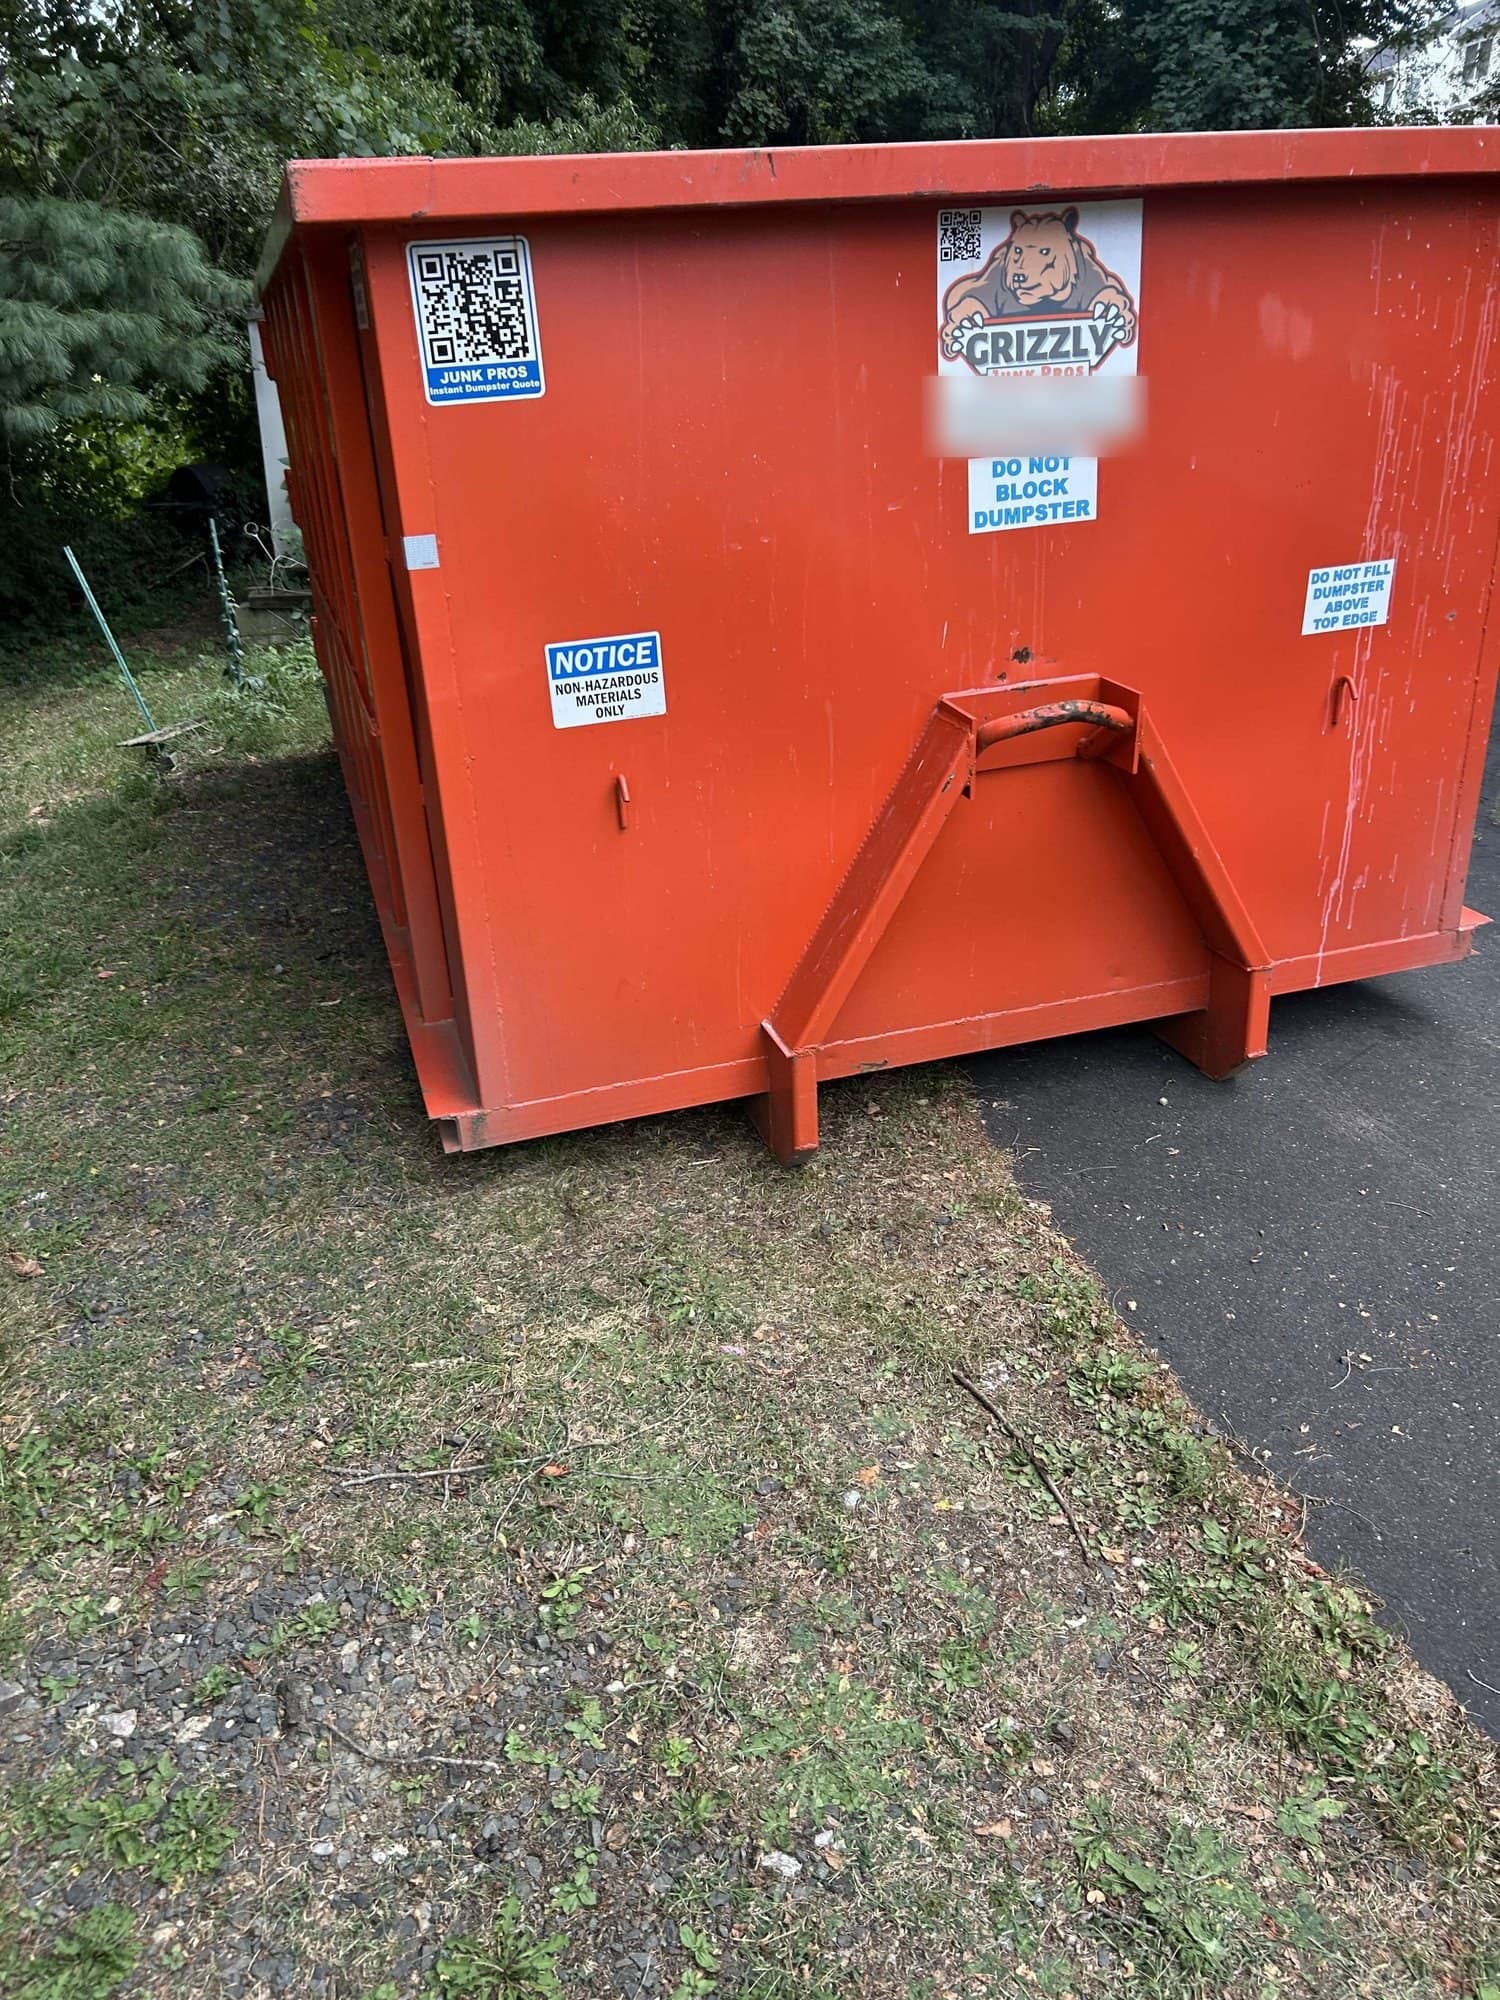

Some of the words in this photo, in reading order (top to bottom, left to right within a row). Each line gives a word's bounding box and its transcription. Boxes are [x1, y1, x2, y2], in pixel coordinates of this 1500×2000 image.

[966, 325, 1112, 365] GRIZZLY
[440, 369, 483, 384] JUNK
[487, 366, 528, 379] PROS
[430, 386, 464, 395] Instant
[465, 382, 510, 393] Dumpster
[512, 379, 540, 389] Quote
[992, 459, 1022, 478] DO
[1029, 456, 1071, 474] NOT
[996, 478, 1069, 502] BLOCK
[974, 499, 1090, 529] DUMPSTER
[1311, 571, 1330, 584] DO
[1333, 567, 1361, 582] NOT
[1363, 563, 1391, 578] FILL
[1313, 579, 1384, 600] DUMPSTER
[1324, 597, 1369, 614] ABOVE
[1313, 616, 1339, 630] TOP
[1342, 610, 1378, 626] EDGE
[555, 641, 653, 675] NOTICE
[555, 672, 659, 696] NON-HAZARDOUS
[576, 688, 642, 707] MATERIALS
[595, 704, 625, 719] ONLY
